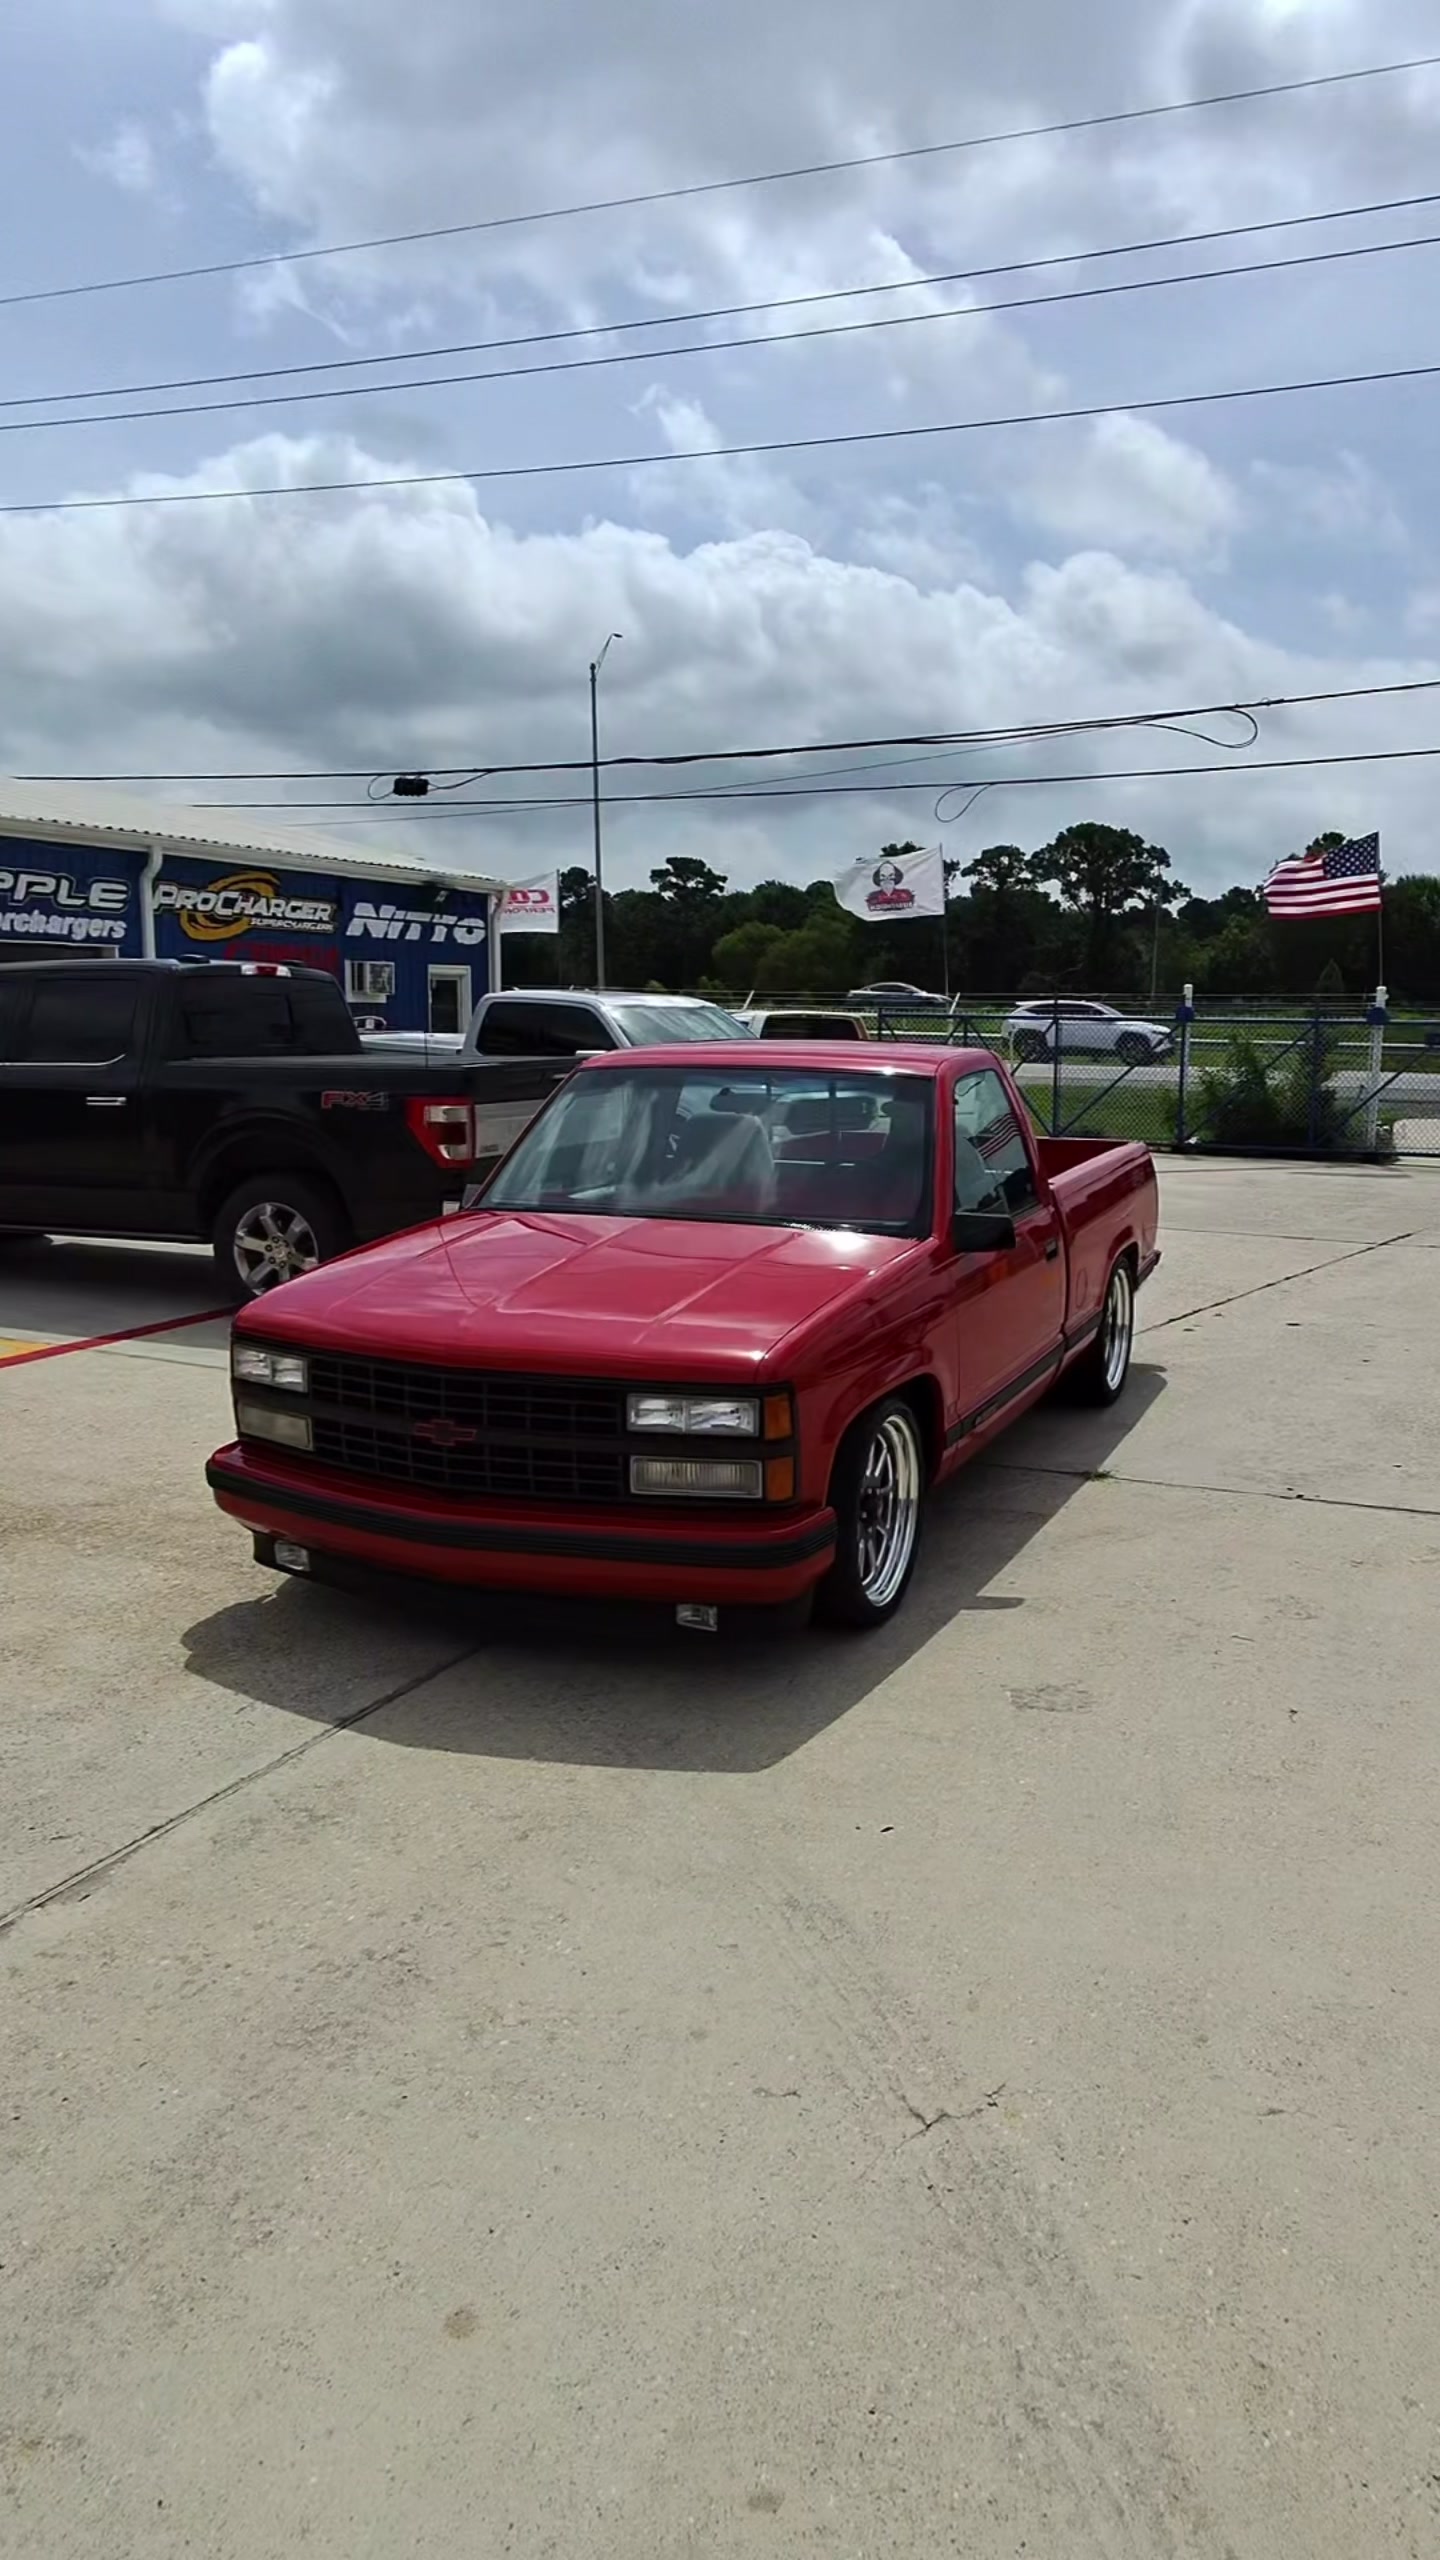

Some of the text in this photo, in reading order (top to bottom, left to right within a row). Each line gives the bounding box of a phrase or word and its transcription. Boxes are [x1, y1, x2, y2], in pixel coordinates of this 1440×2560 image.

[0, 909, 127, 940] rchargers
[346, 902, 486, 945] NITTO
[321, 1091, 386, 1109] FX4
